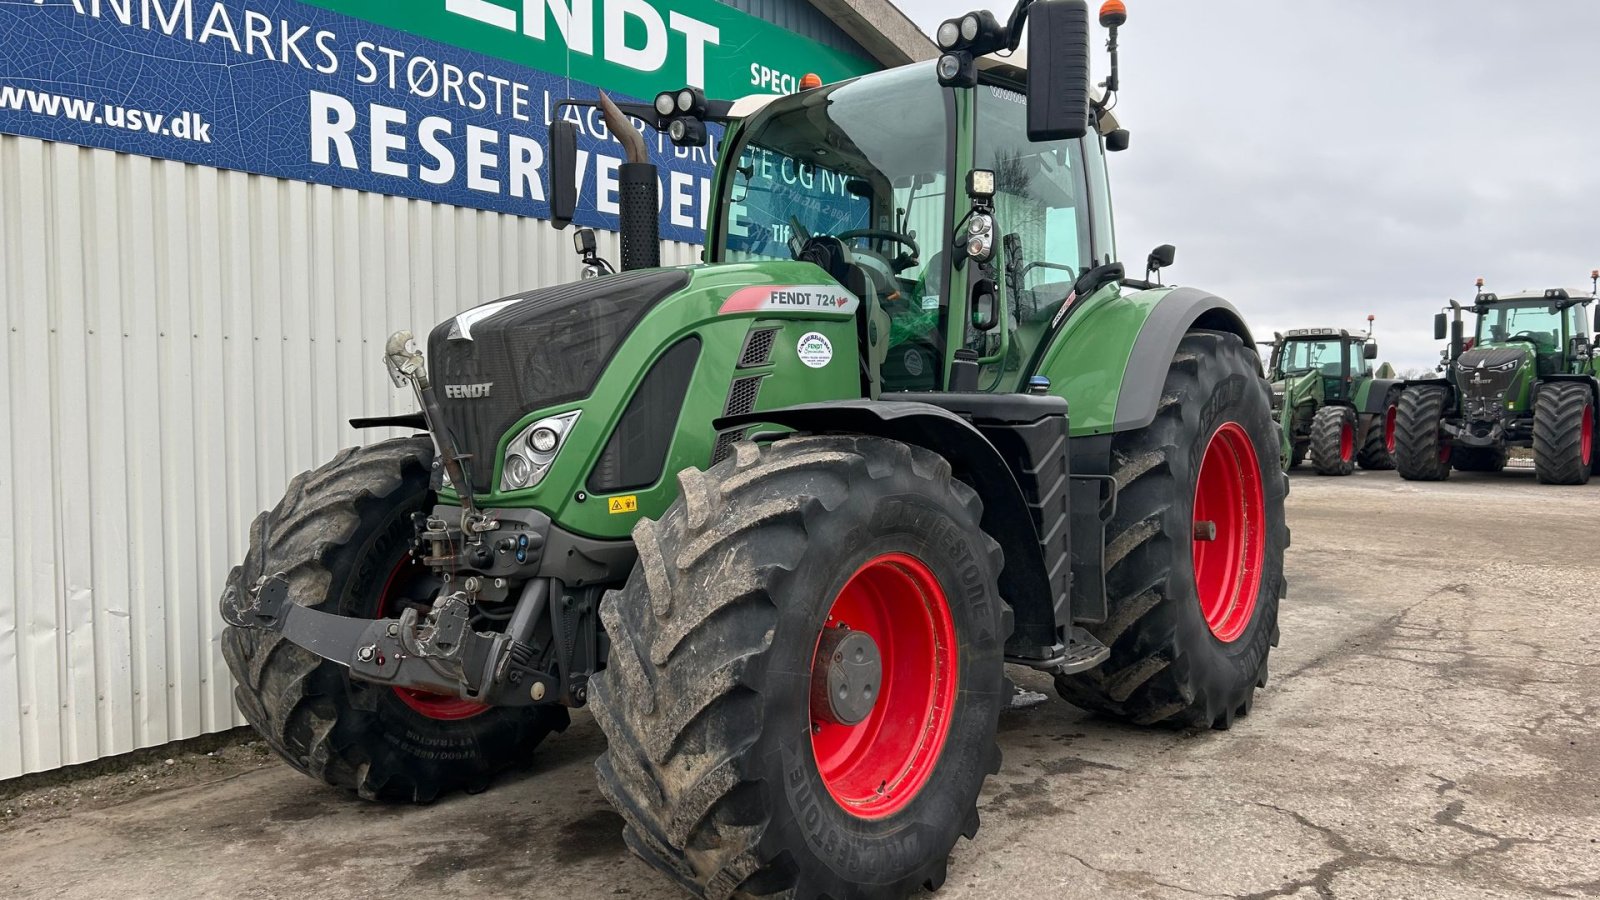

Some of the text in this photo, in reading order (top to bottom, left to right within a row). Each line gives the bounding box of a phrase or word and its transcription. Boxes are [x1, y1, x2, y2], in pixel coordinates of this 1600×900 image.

[355, 41, 529, 121] STØRSTE
[544, 89, 646, 143] LAGR
[750, 62, 801, 95] SPECI
[0, 86, 211, 143] www.usv.dk
[310, 90, 749, 238] RESEREEE
[770, 291, 812, 306] FENDT
[815, 293, 836, 307] 724
[445, 382, 494, 399] FENDT
